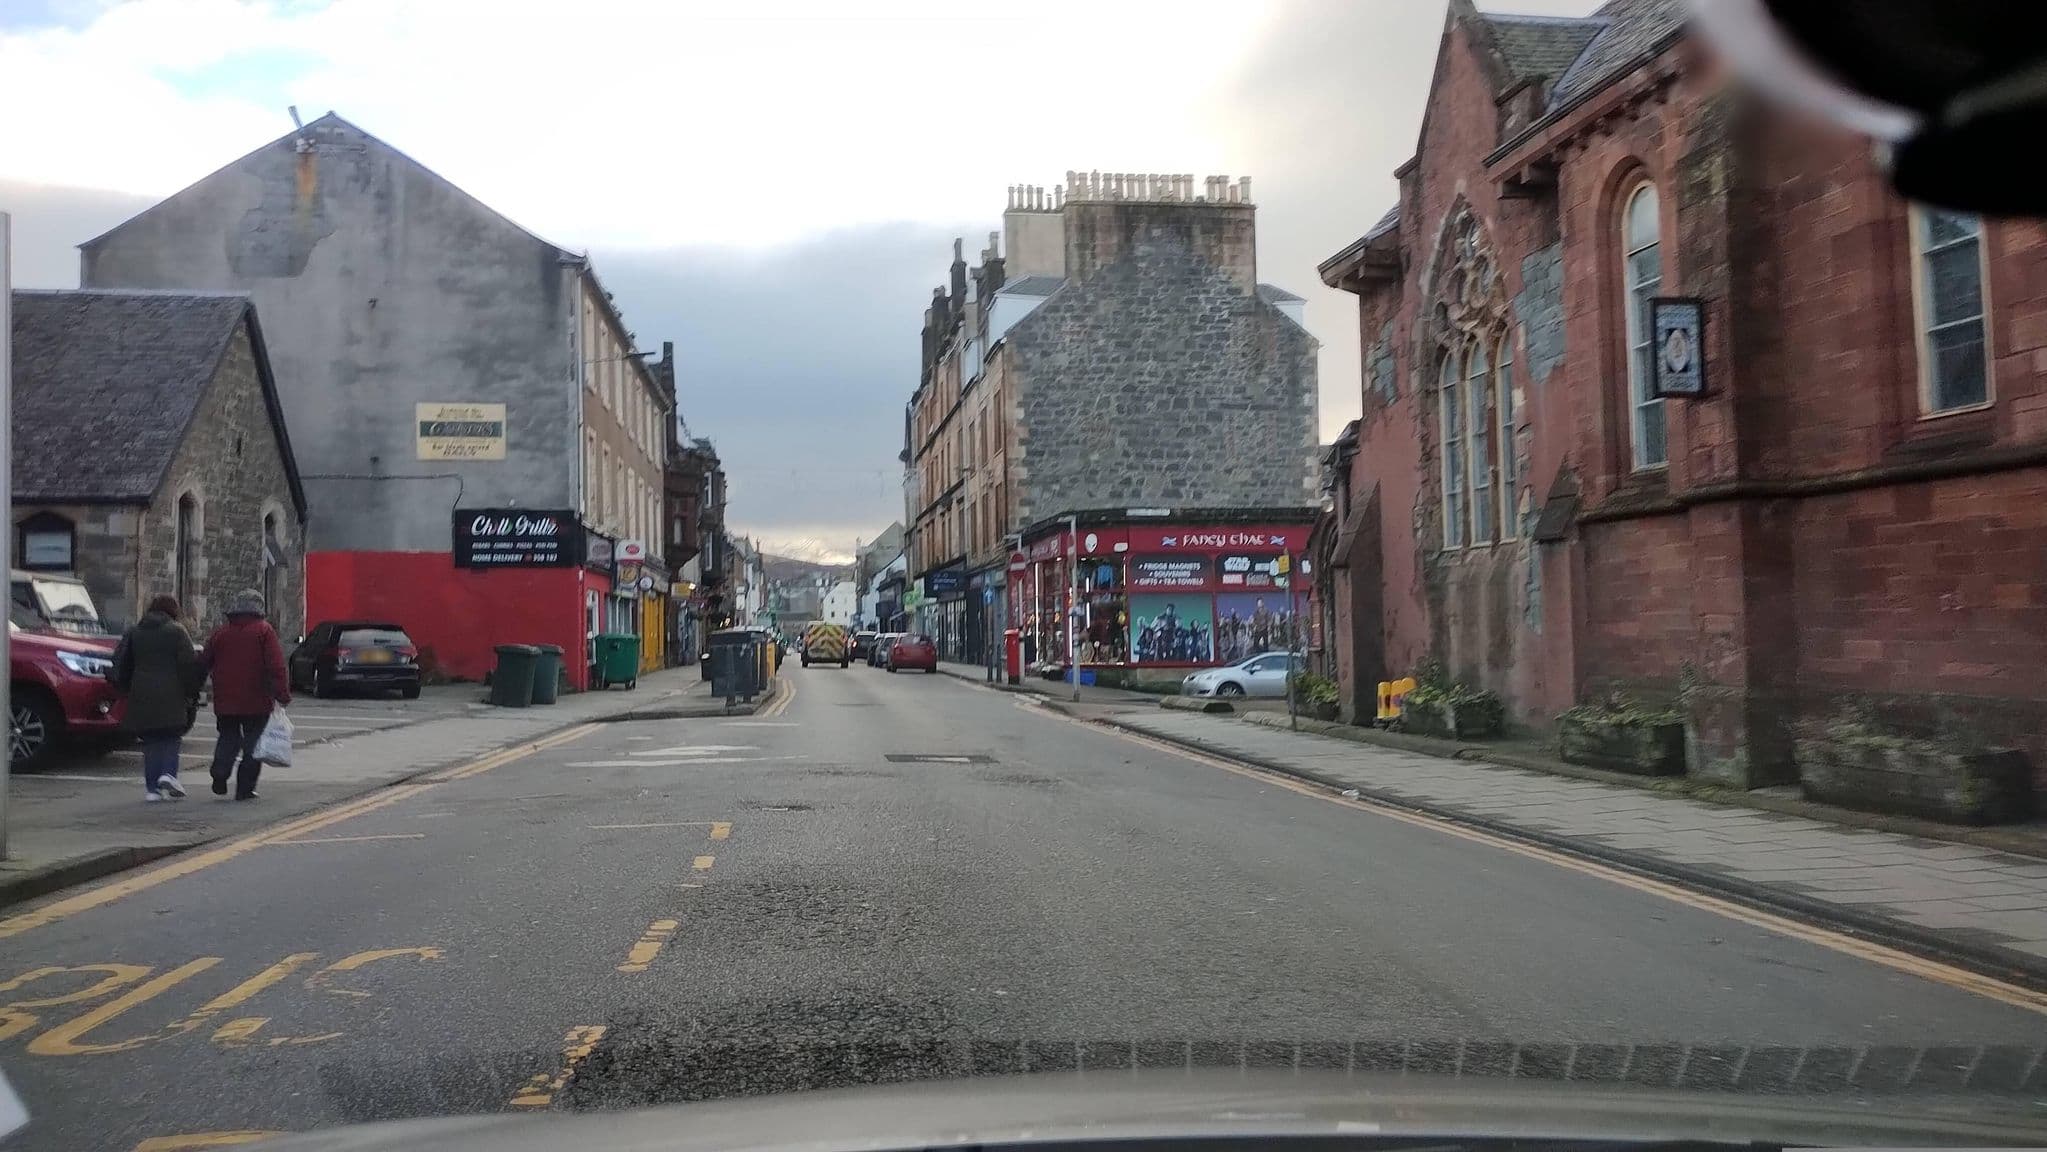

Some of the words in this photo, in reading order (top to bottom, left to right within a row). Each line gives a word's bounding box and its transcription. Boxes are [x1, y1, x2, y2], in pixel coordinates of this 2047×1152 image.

[515, 515, 559, 536] Grillz
[472, 553, 491, 562] HOME
[493, 553, 523, 562] DELIVERY
[1143, 562, 1167, 570] FRIDGE
[1168, 562, 1201, 570] MAGNETS
[0, 946, 447, 1055] BUS
